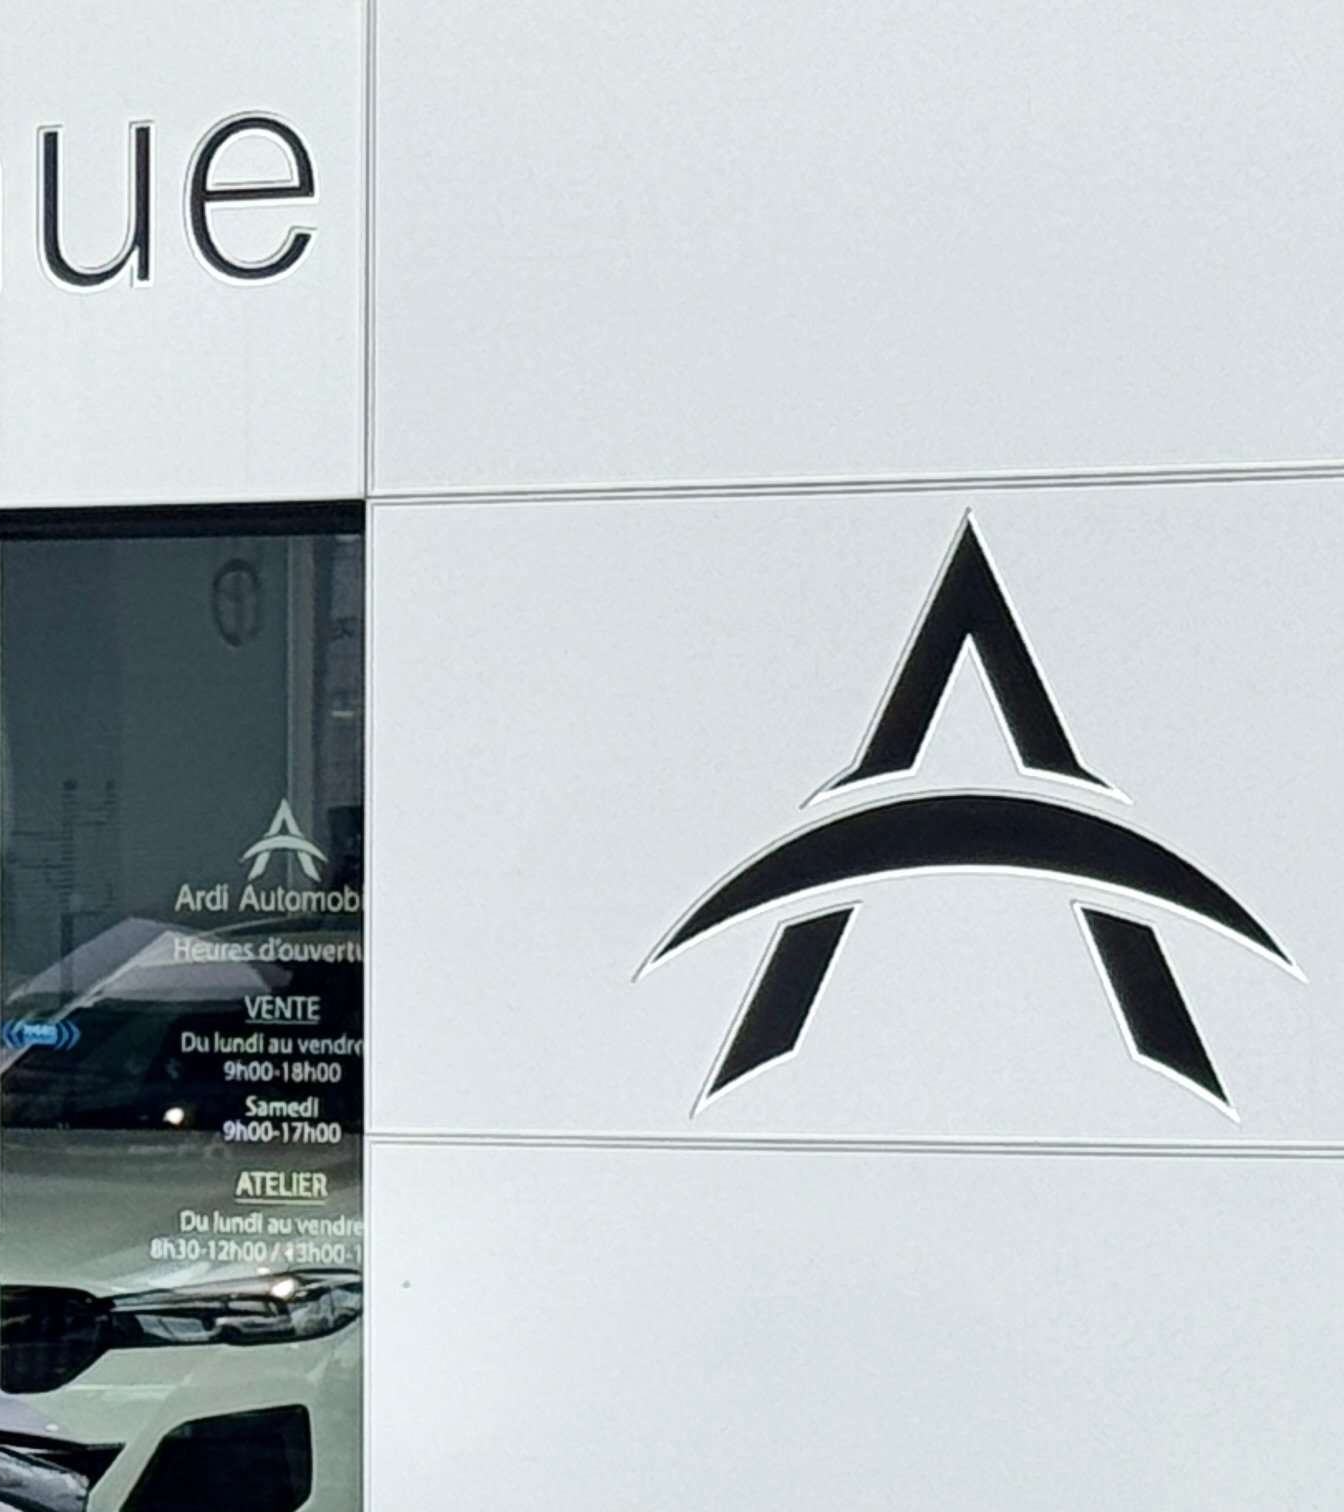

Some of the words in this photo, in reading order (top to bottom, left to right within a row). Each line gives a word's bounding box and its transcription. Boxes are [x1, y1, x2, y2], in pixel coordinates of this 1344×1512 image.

[175, 883, 229, 912] Ardi
[238, 883, 365, 913] Automob
[174, 937, 255, 963] Heures
[243, 995, 321, 1022] VENTE
[181, 1031, 210, 1053] Du
[213, 1031, 265, 1054] lundi
[267, 1037, 293, 1054] au
[223, 1060, 342, 1083] 9h00-18h00
[244, 1095, 320, 1118] Samedi
[222, 1119, 342, 1143] 9h00-17h00
[235, 1171, 329, 1198] ATELIER
[179, 1210, 209, 1233] Du
[212, 1210, 263, 1235] lundi
[267, 1216, 292, 1235] au
[149, 1239, 268, 1262] 8h30-12h00
